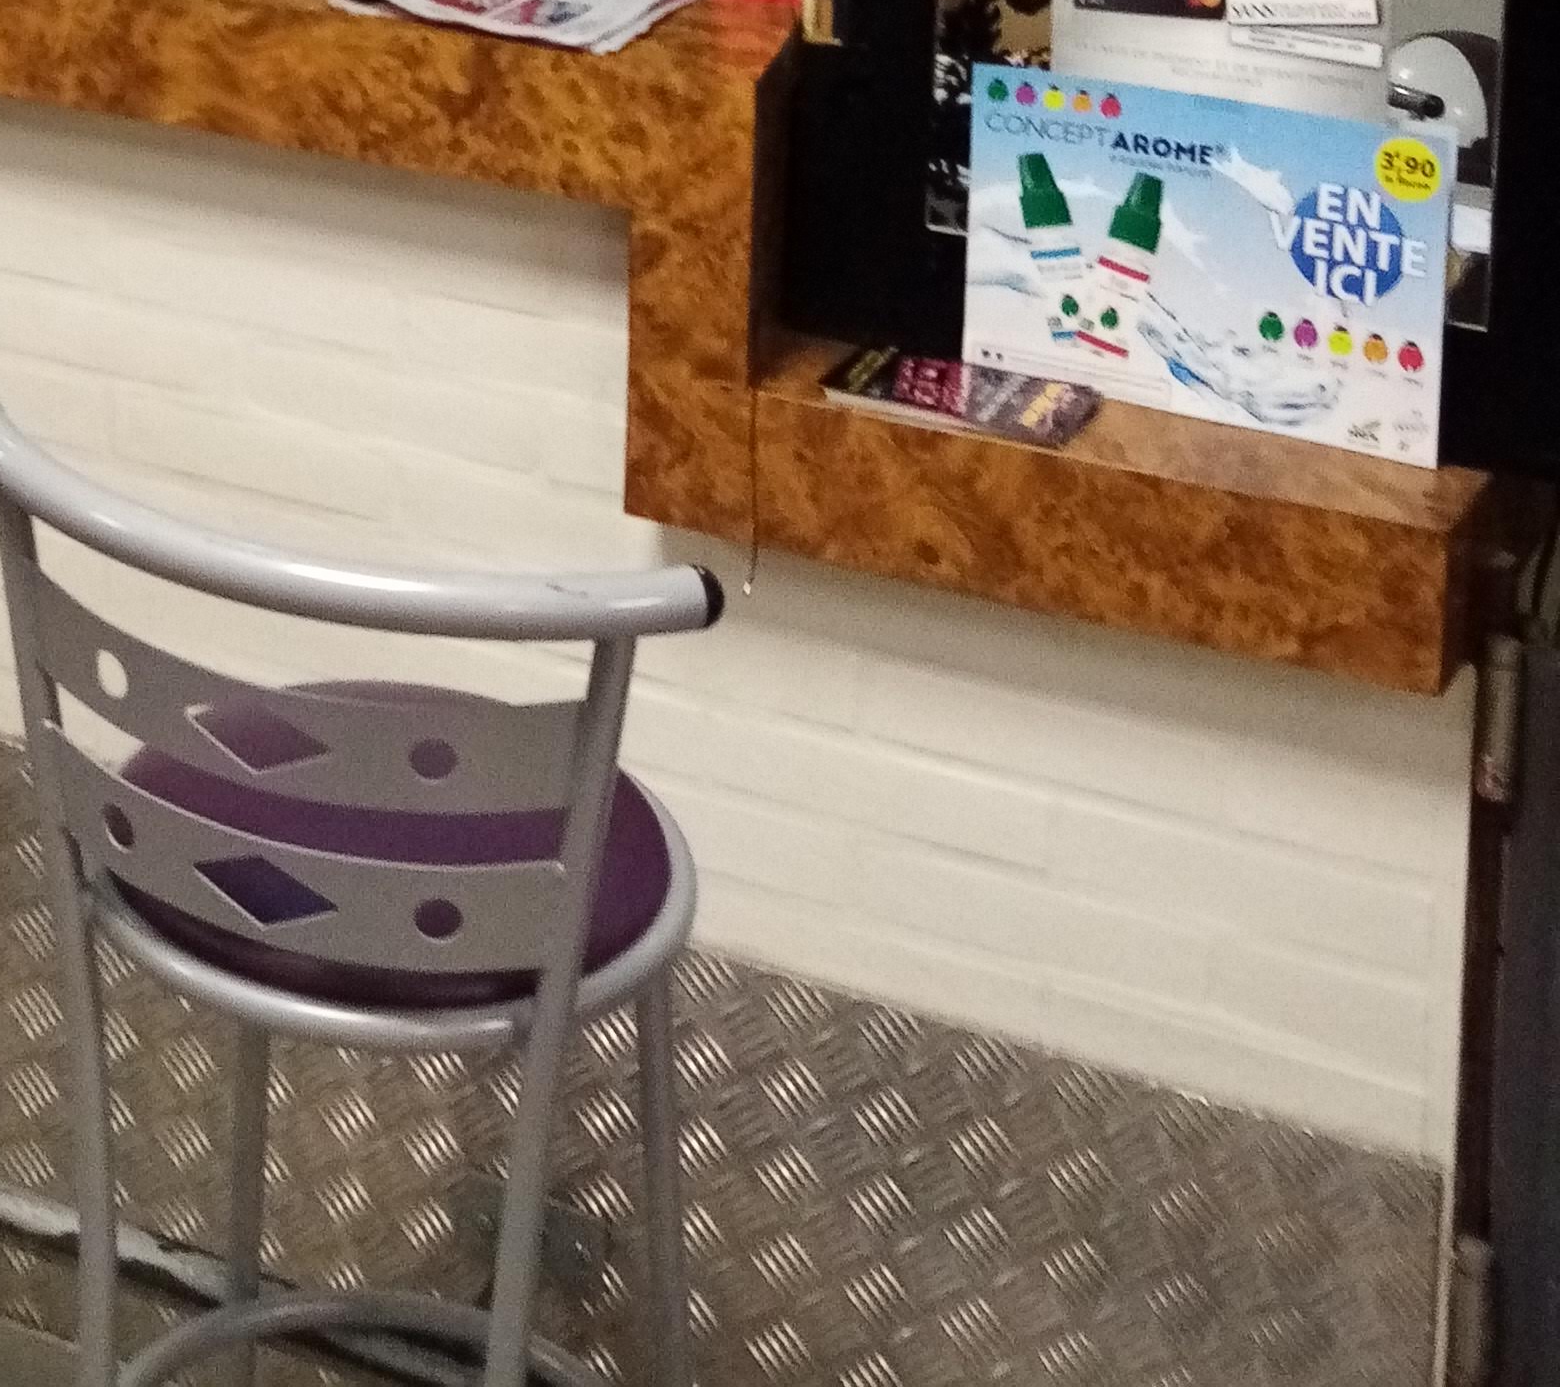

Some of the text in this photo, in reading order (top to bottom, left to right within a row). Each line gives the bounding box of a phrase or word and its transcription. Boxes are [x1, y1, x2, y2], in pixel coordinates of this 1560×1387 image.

[1316, 181, 1382, 231] EN
[1269, 209, 1430, 279] VENTE
[1312, 257, 1378, 308] ICI
